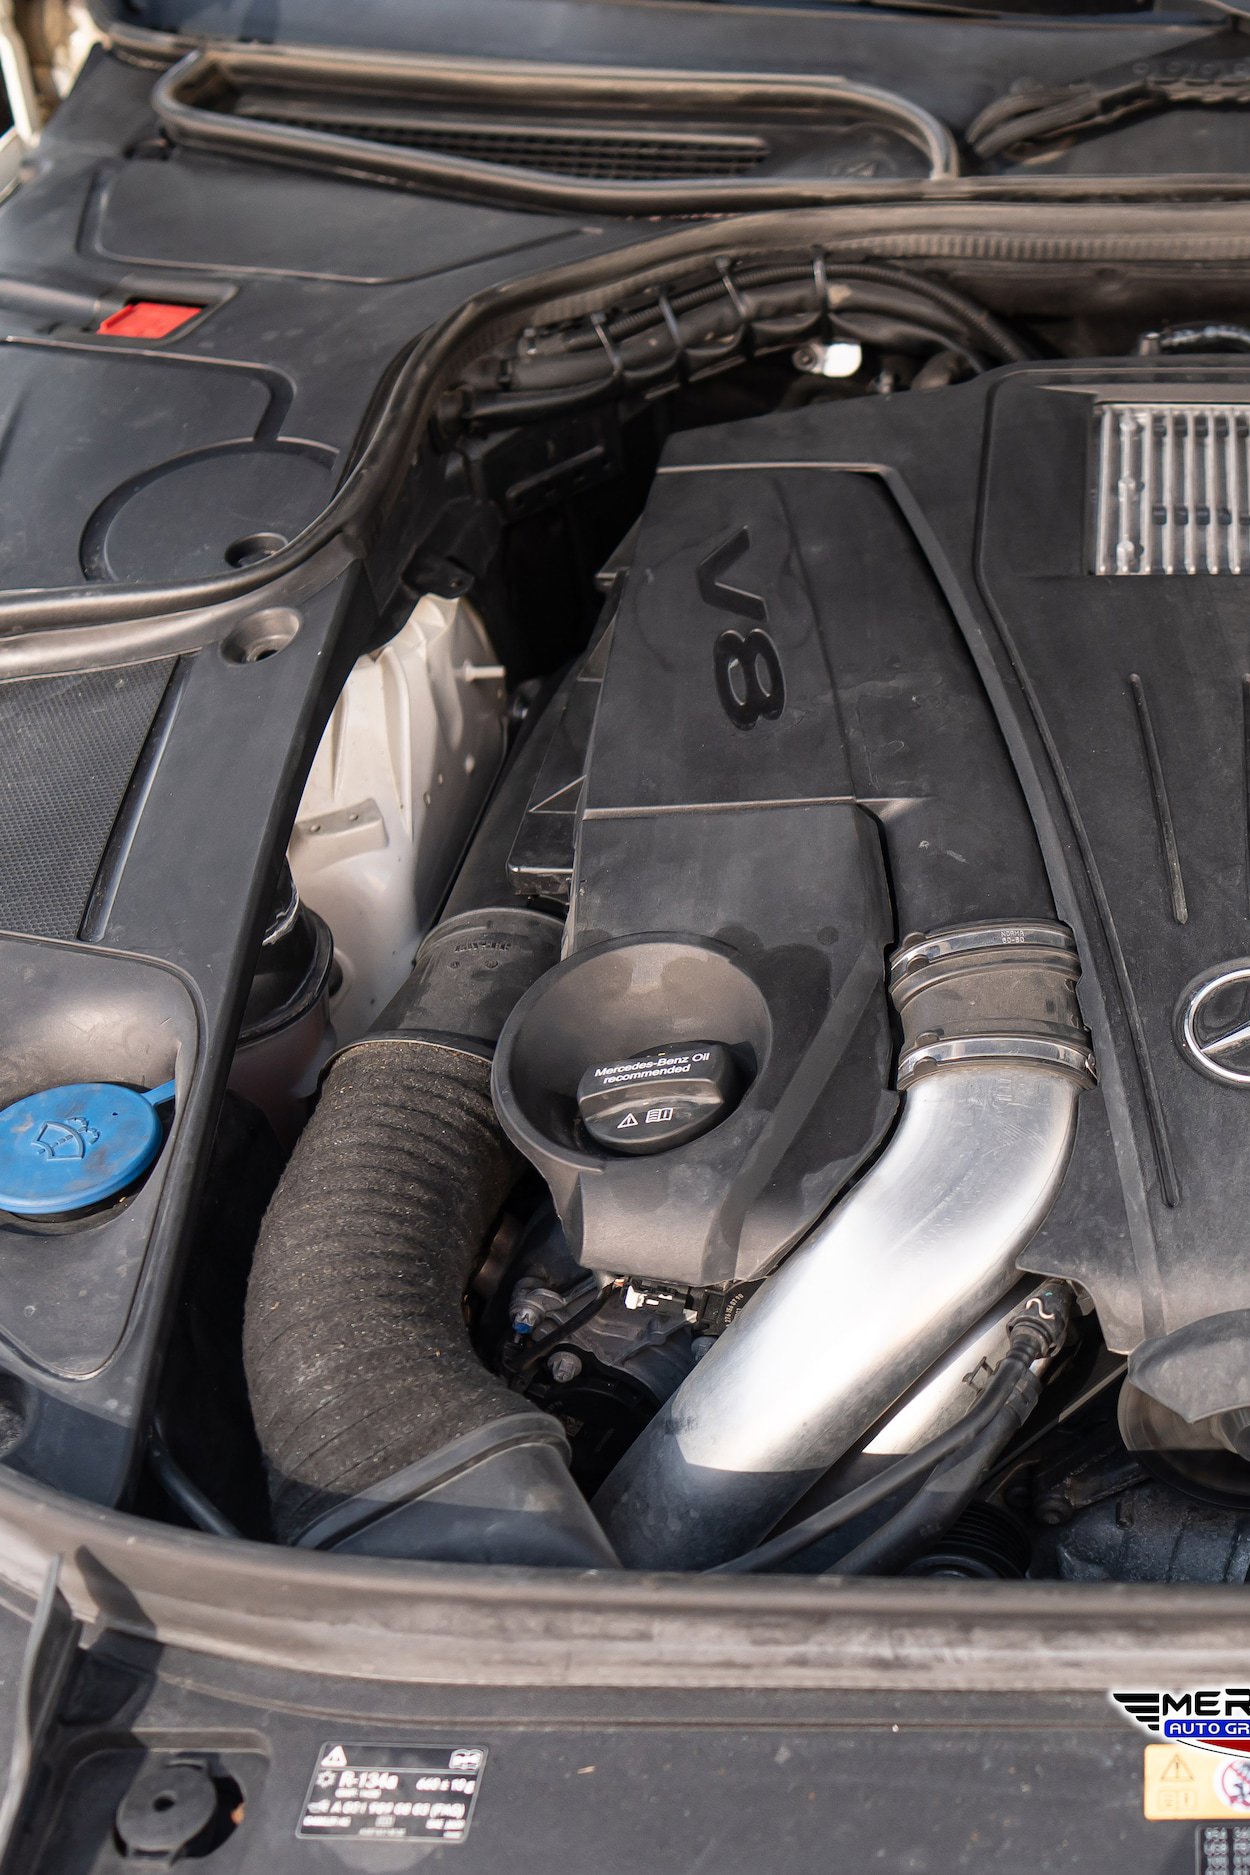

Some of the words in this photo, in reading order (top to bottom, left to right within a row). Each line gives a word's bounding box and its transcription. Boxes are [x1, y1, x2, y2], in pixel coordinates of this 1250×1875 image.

[697, 525, 787, 731] V8
[594, 1055, 689, 1077] Mercedes-Benz
[692, 1052, 710, 1063] Oil
[603, 1064, 691, 1084] recommended
